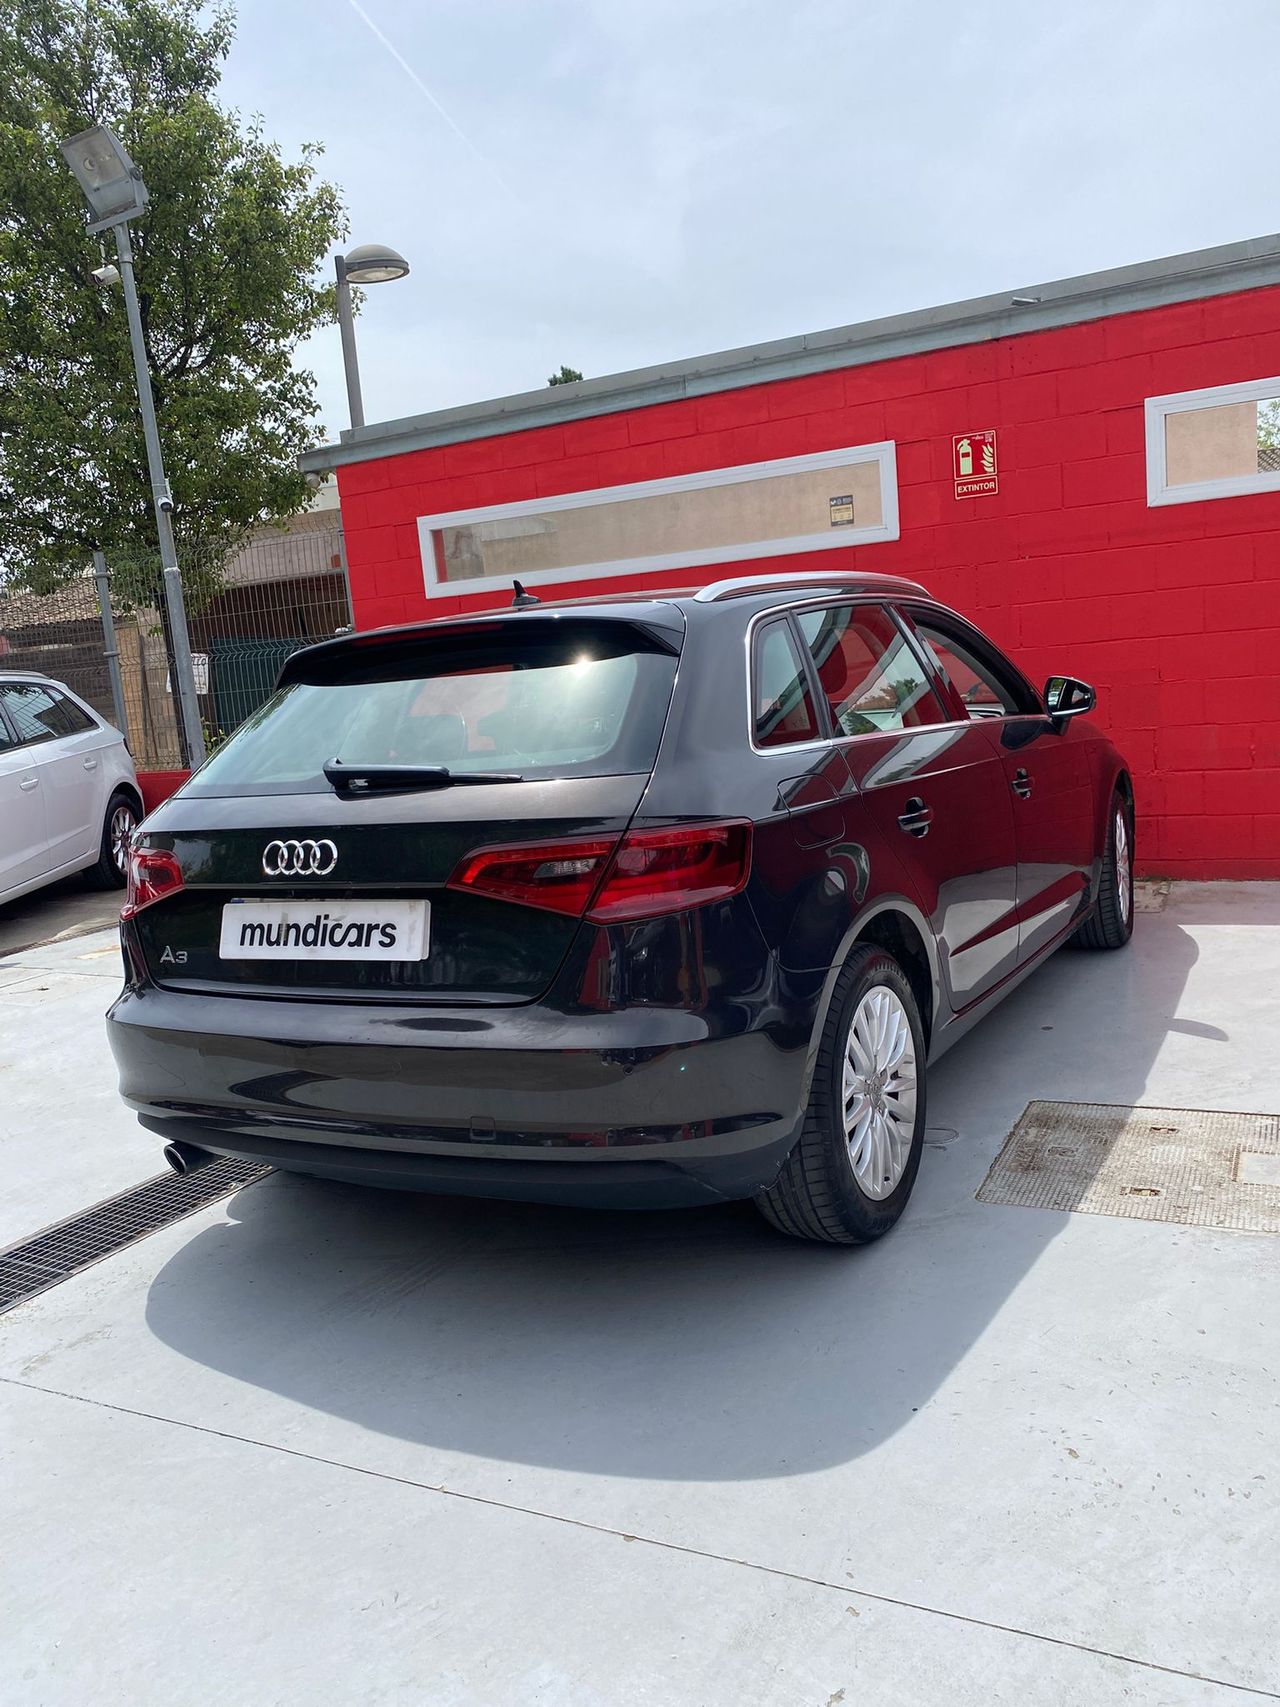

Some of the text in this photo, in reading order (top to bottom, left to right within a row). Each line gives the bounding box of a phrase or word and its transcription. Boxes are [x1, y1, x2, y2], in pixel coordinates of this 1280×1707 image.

[957, 481, 995, 493] EXTINTOR
[239, 914, 397, 948] mundicars
[159, 945, 188, 964] A3
